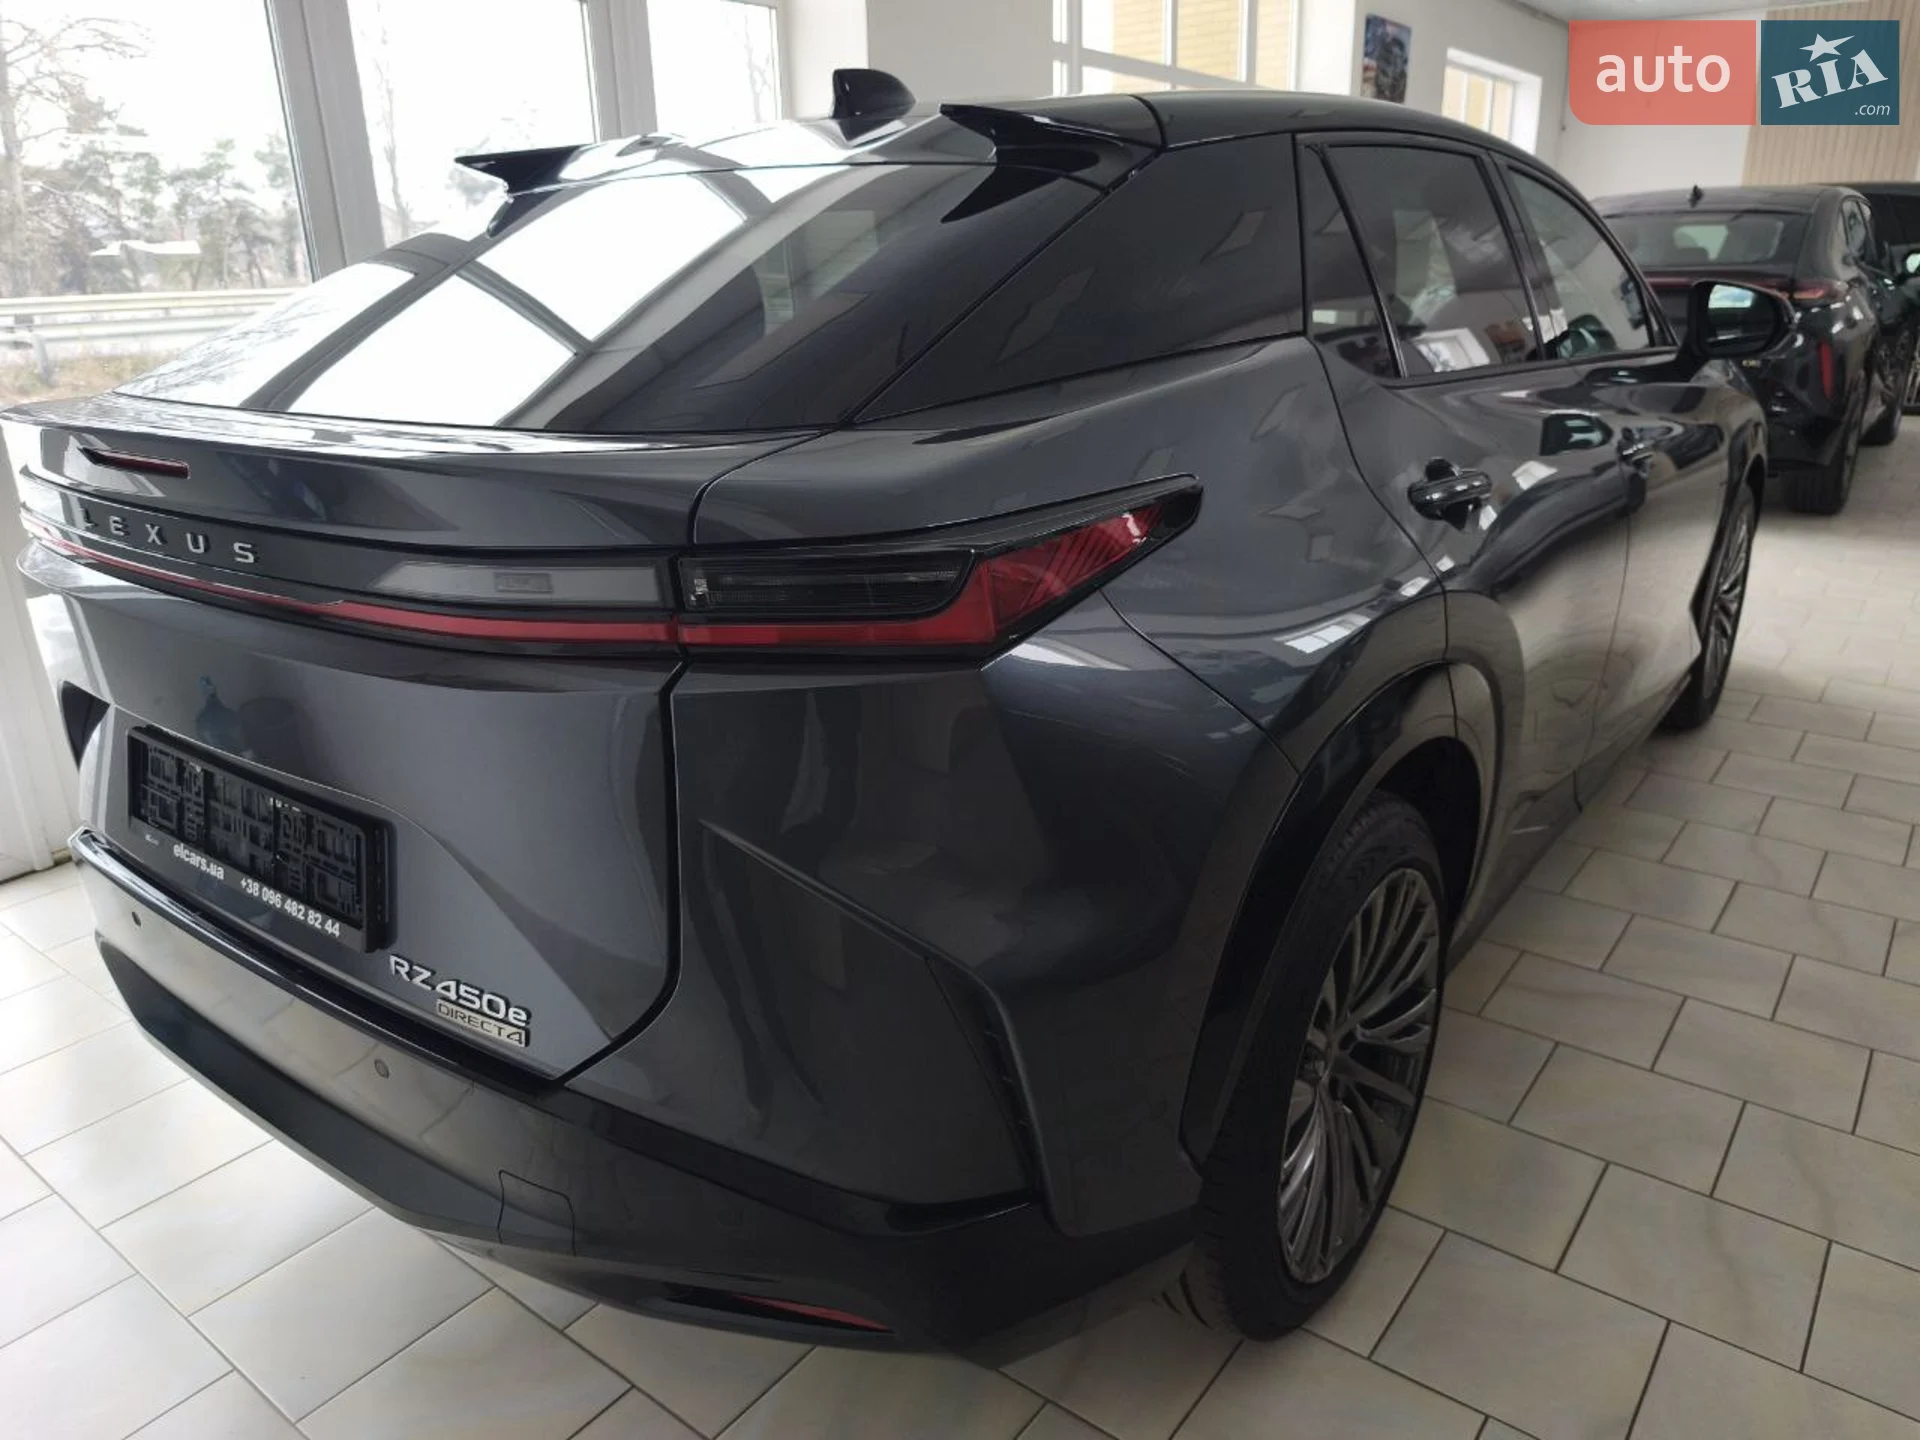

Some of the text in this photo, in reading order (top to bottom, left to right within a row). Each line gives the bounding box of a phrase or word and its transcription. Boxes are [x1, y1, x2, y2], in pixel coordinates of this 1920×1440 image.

[77, 507, 255, 564] LEXUS
[173, 842, 340, 938] elcars.ua +38 096 482 82 44
